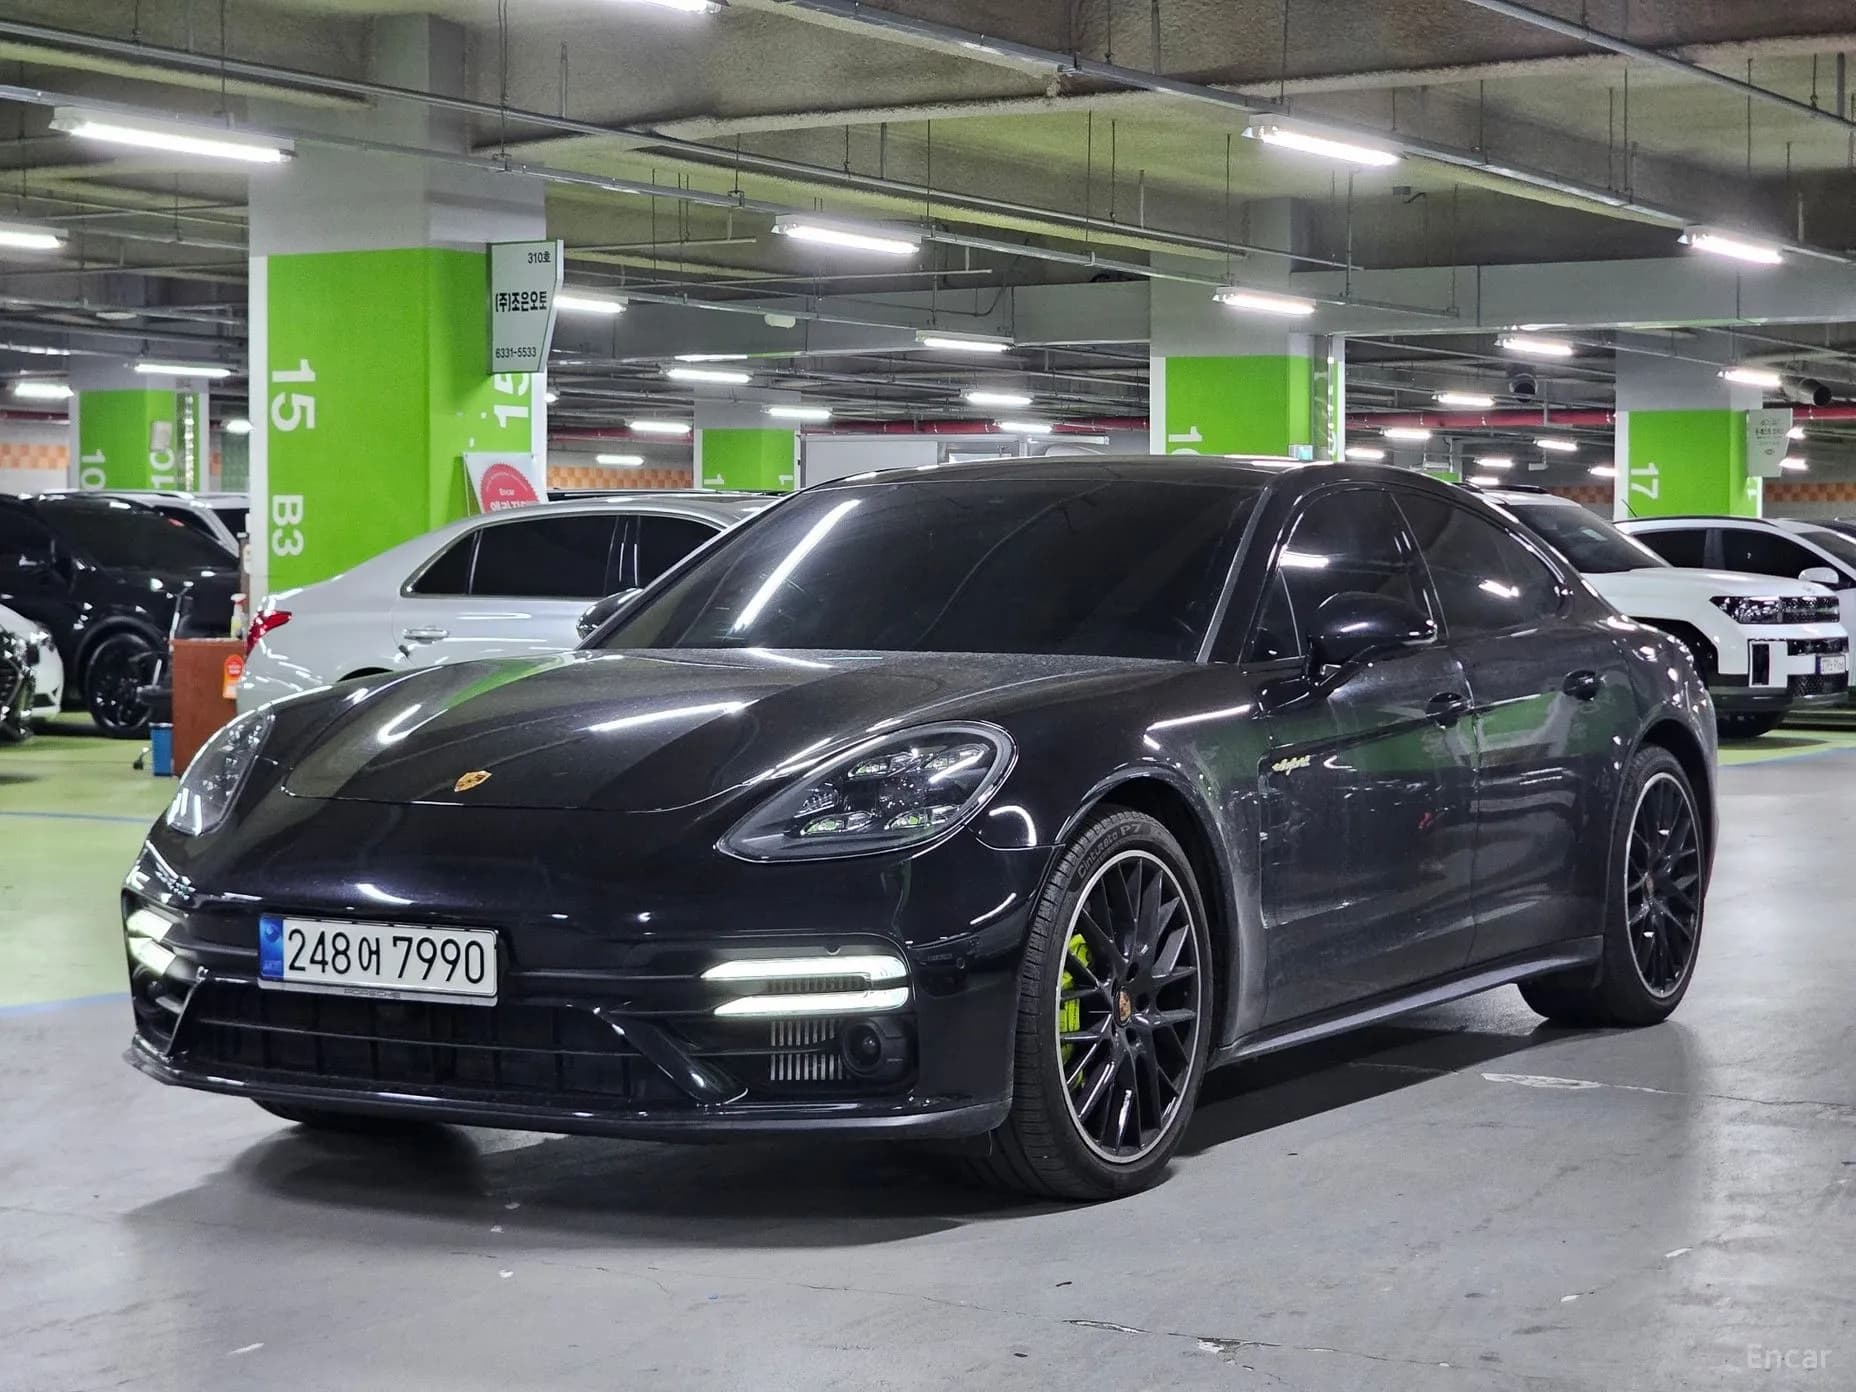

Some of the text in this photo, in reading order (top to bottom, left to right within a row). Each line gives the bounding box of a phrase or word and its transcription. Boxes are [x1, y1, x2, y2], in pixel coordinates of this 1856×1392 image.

[528, 250, 551, 264] 310호
[495, 290, 548, 313] (주)조은오토
[495, 346, 537, 359] 6331-5533
[271, 358, 317, 432] 15
[1168, 426, 1203, 455] 1
[81, 448, 106, 490] 10
[149, 447, 176, 490] 10
[1630, 462, 1660, 499] 17
[272, 494, 305, 557] B3
[1120, 822, 1142, 836] P7
[288, 928, 485, 985] 248어 7990
